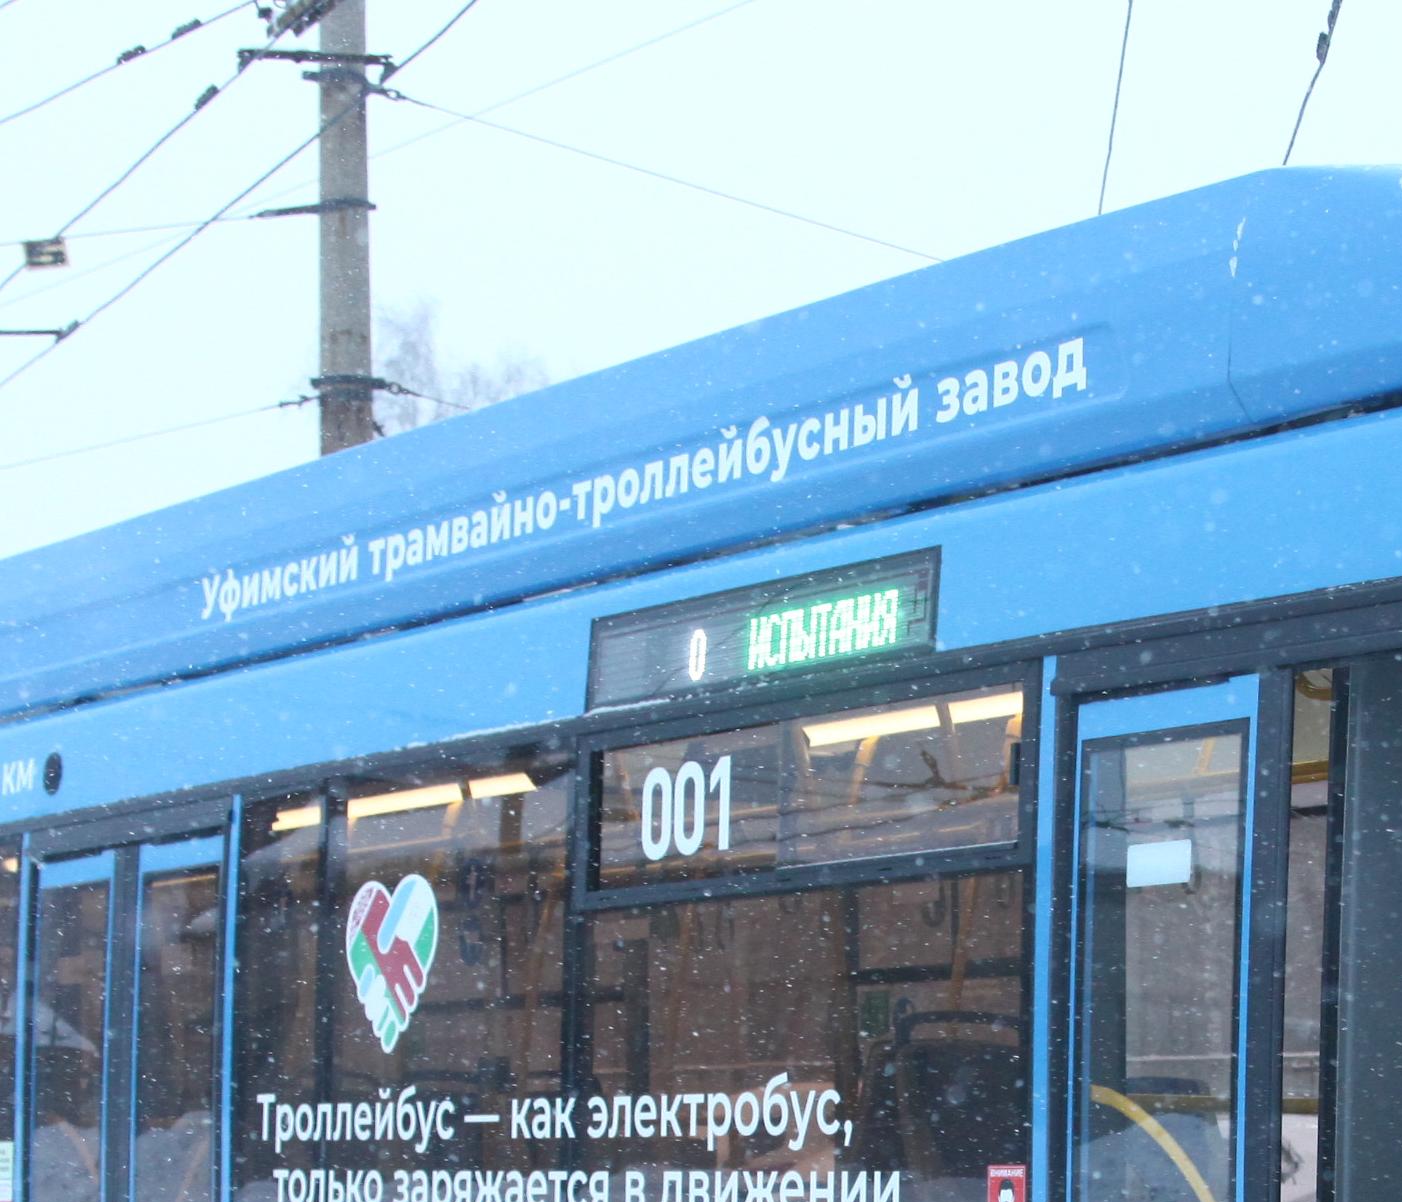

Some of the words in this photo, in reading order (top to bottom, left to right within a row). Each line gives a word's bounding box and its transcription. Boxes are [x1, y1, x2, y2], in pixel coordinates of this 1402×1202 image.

[201, 534, 360, 622] Уфимский
[368, 377, 920, 581] трамвайно-троллейбусный
[936, 337, 1087, 422] завод
[746, 588, 900, 672] ИСПЫТАНИЯ
[641, 754, 732, 862] 001
[256, 1085, 456, 1155] Троллейбус
[509, 1092, 576, 1141] как
[586, 1071, 855, 1154] электробус,
